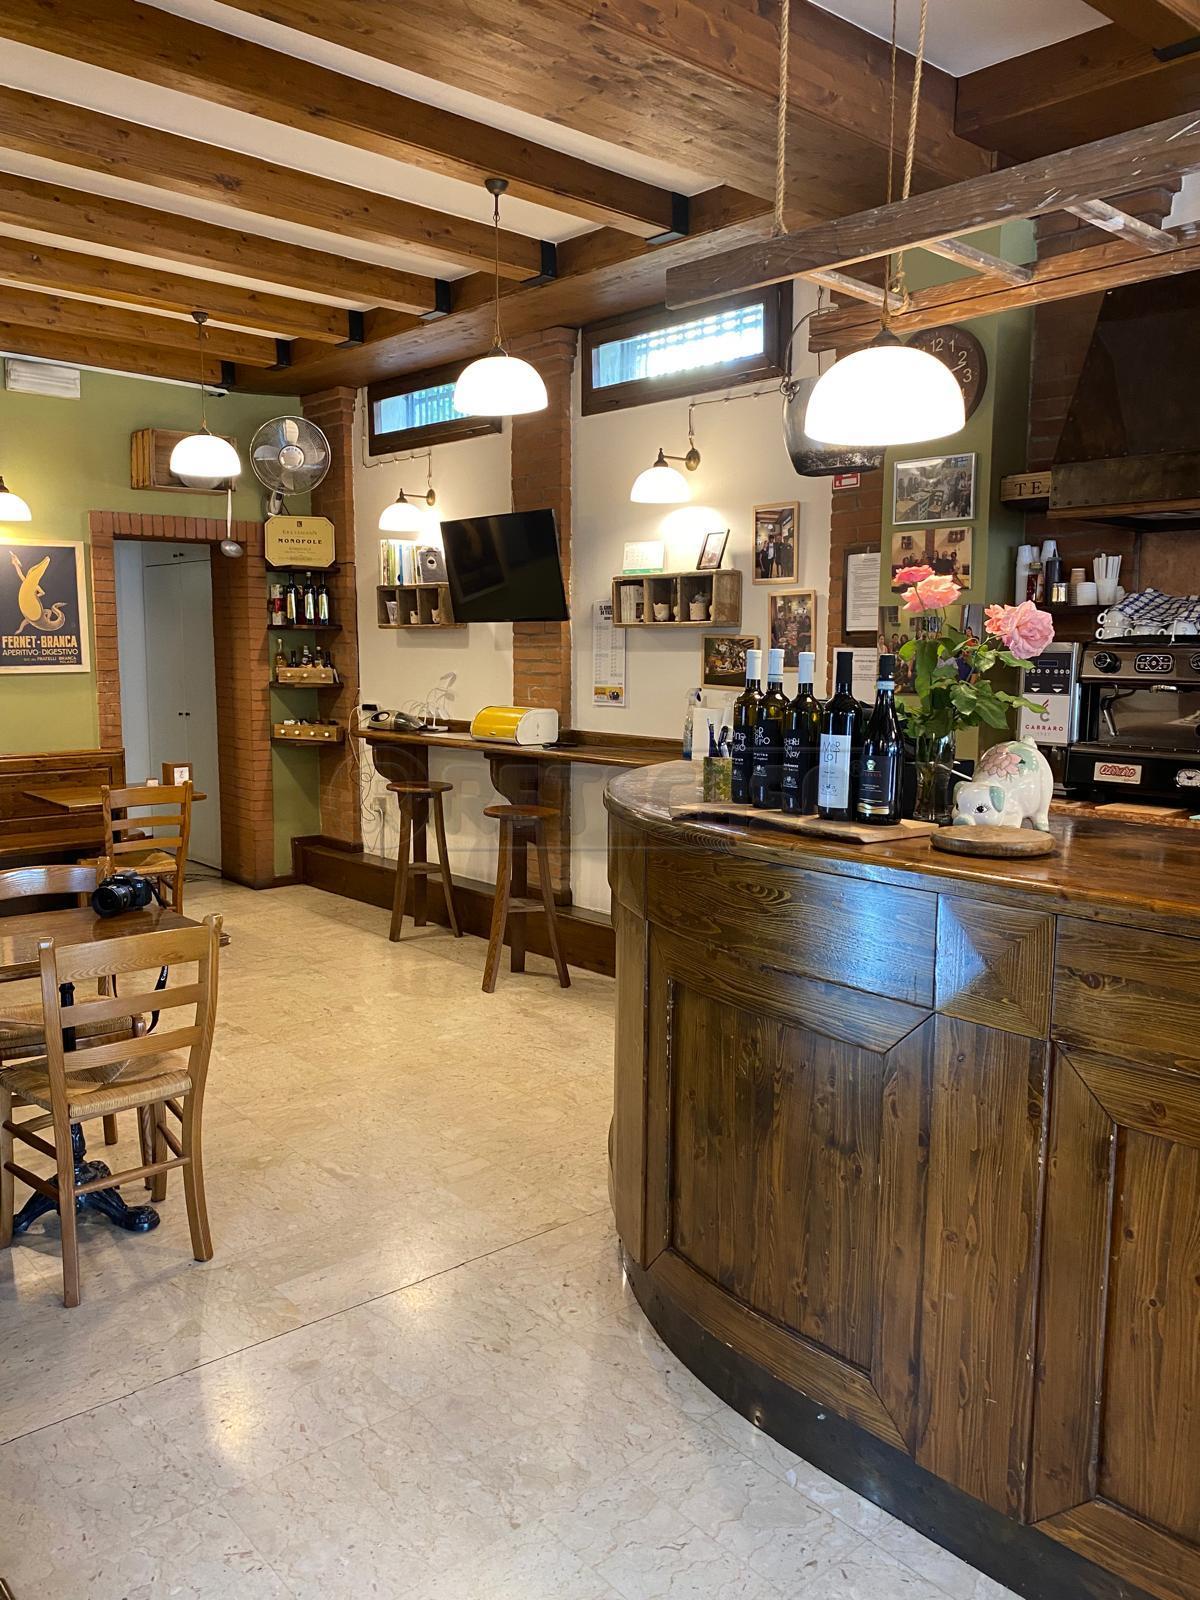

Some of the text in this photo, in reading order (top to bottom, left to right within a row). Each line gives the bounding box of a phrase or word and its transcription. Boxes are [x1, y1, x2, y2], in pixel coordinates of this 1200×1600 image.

[930, 338, 944, 352] 12
[949, 339, 955, 352] 1
[958, 351, 968, 364] 2
[963, 368, 972, 383] 3
[1015, 481, 1051, 497] TE
